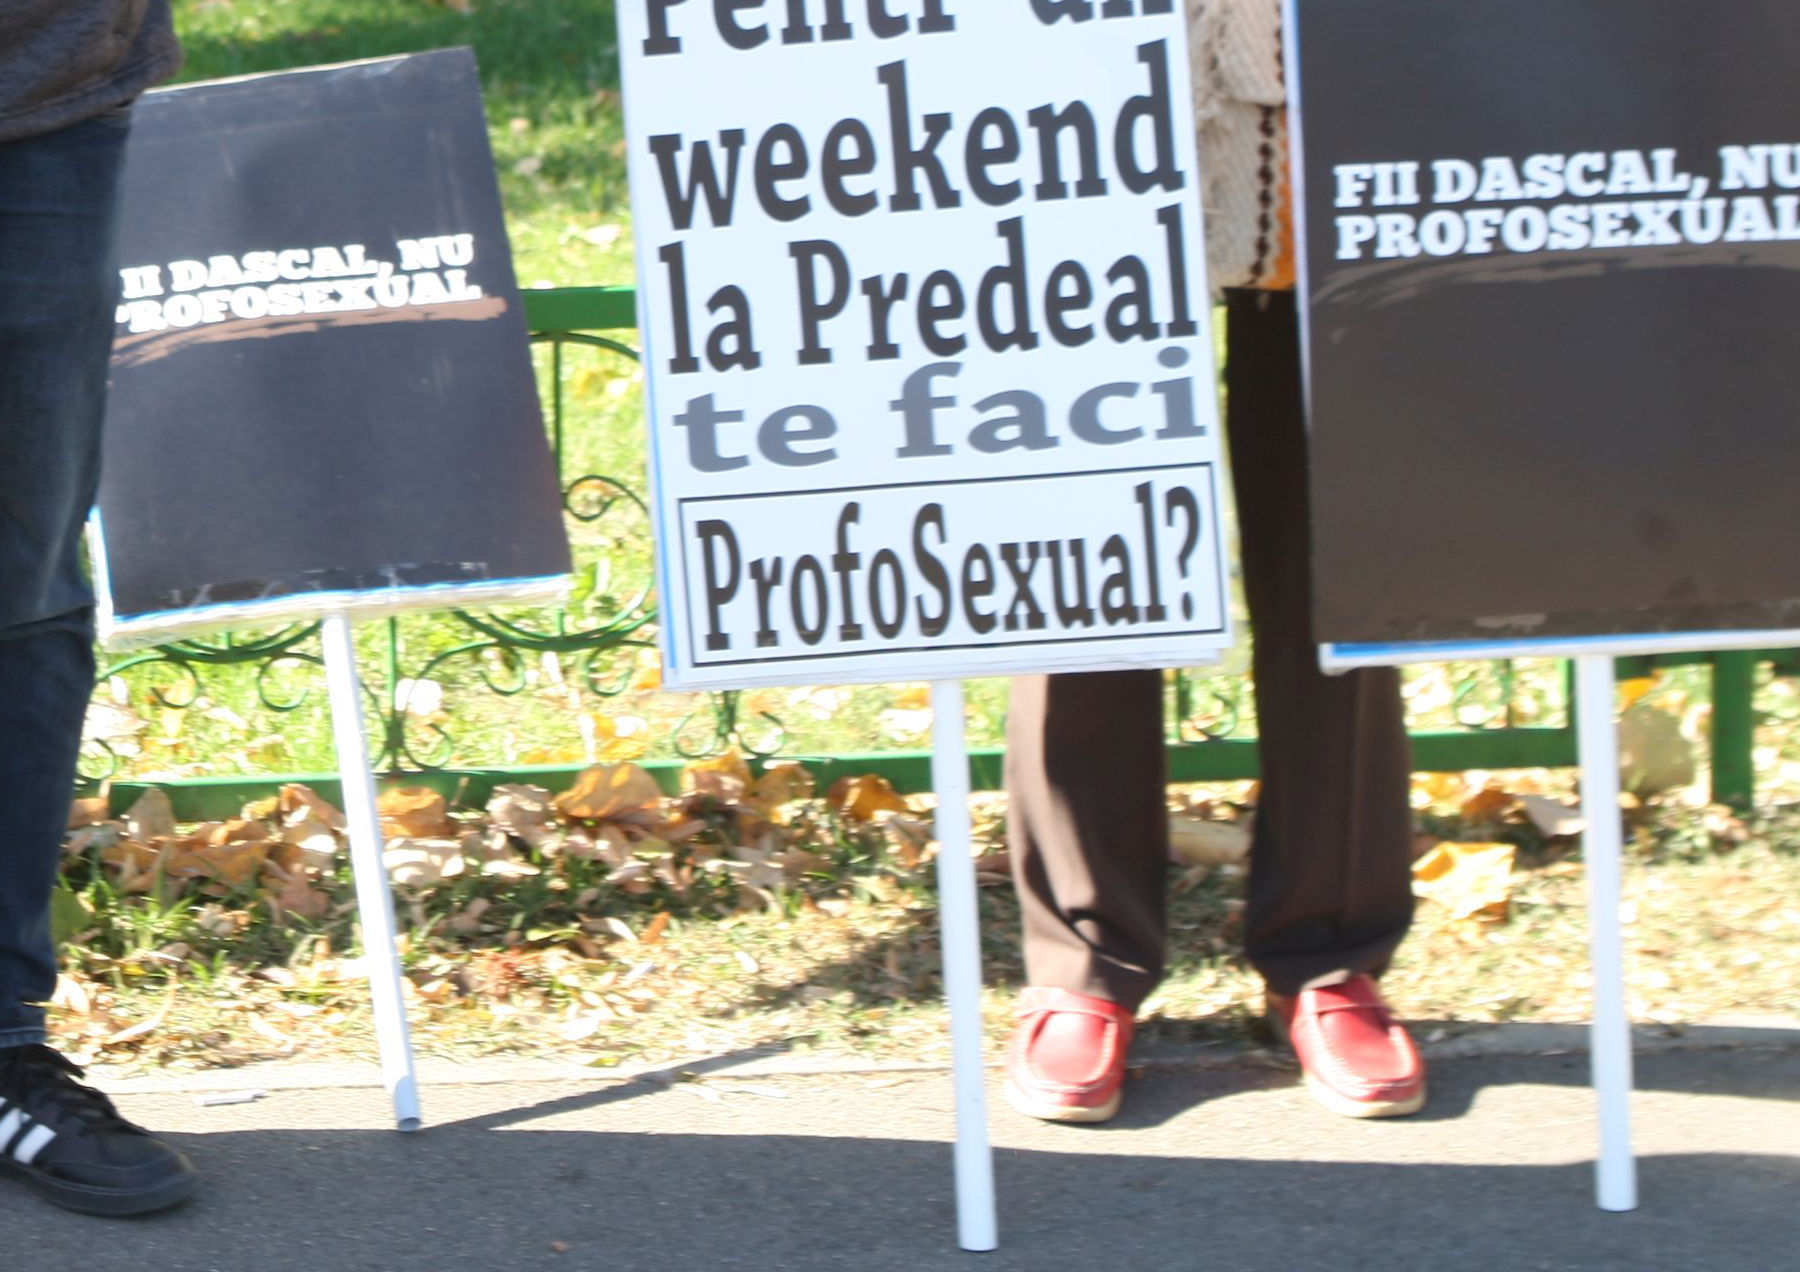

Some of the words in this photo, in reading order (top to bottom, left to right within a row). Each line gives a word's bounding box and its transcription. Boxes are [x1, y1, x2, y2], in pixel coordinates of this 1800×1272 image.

[648, 38, 1186, 231] weekend
[1333, 161, 1420, 208] FII
[1431, 148, 1710, 203] DASCAL,
[119, 265, 164, 299] II
[167, 244, 394, 292] DASCAL,
[397, 233, 474, 271] NU
[659, 241, 762, 375] la
[788, 203, 1199, 366] Predeal
[1335, 194, 1800, 260] PROFOSEXUAL
[674, 393, 838, 473] te
[890, 347, 1206, 458] faci
[696, 480, 1201, 652] ProfoSexual?
